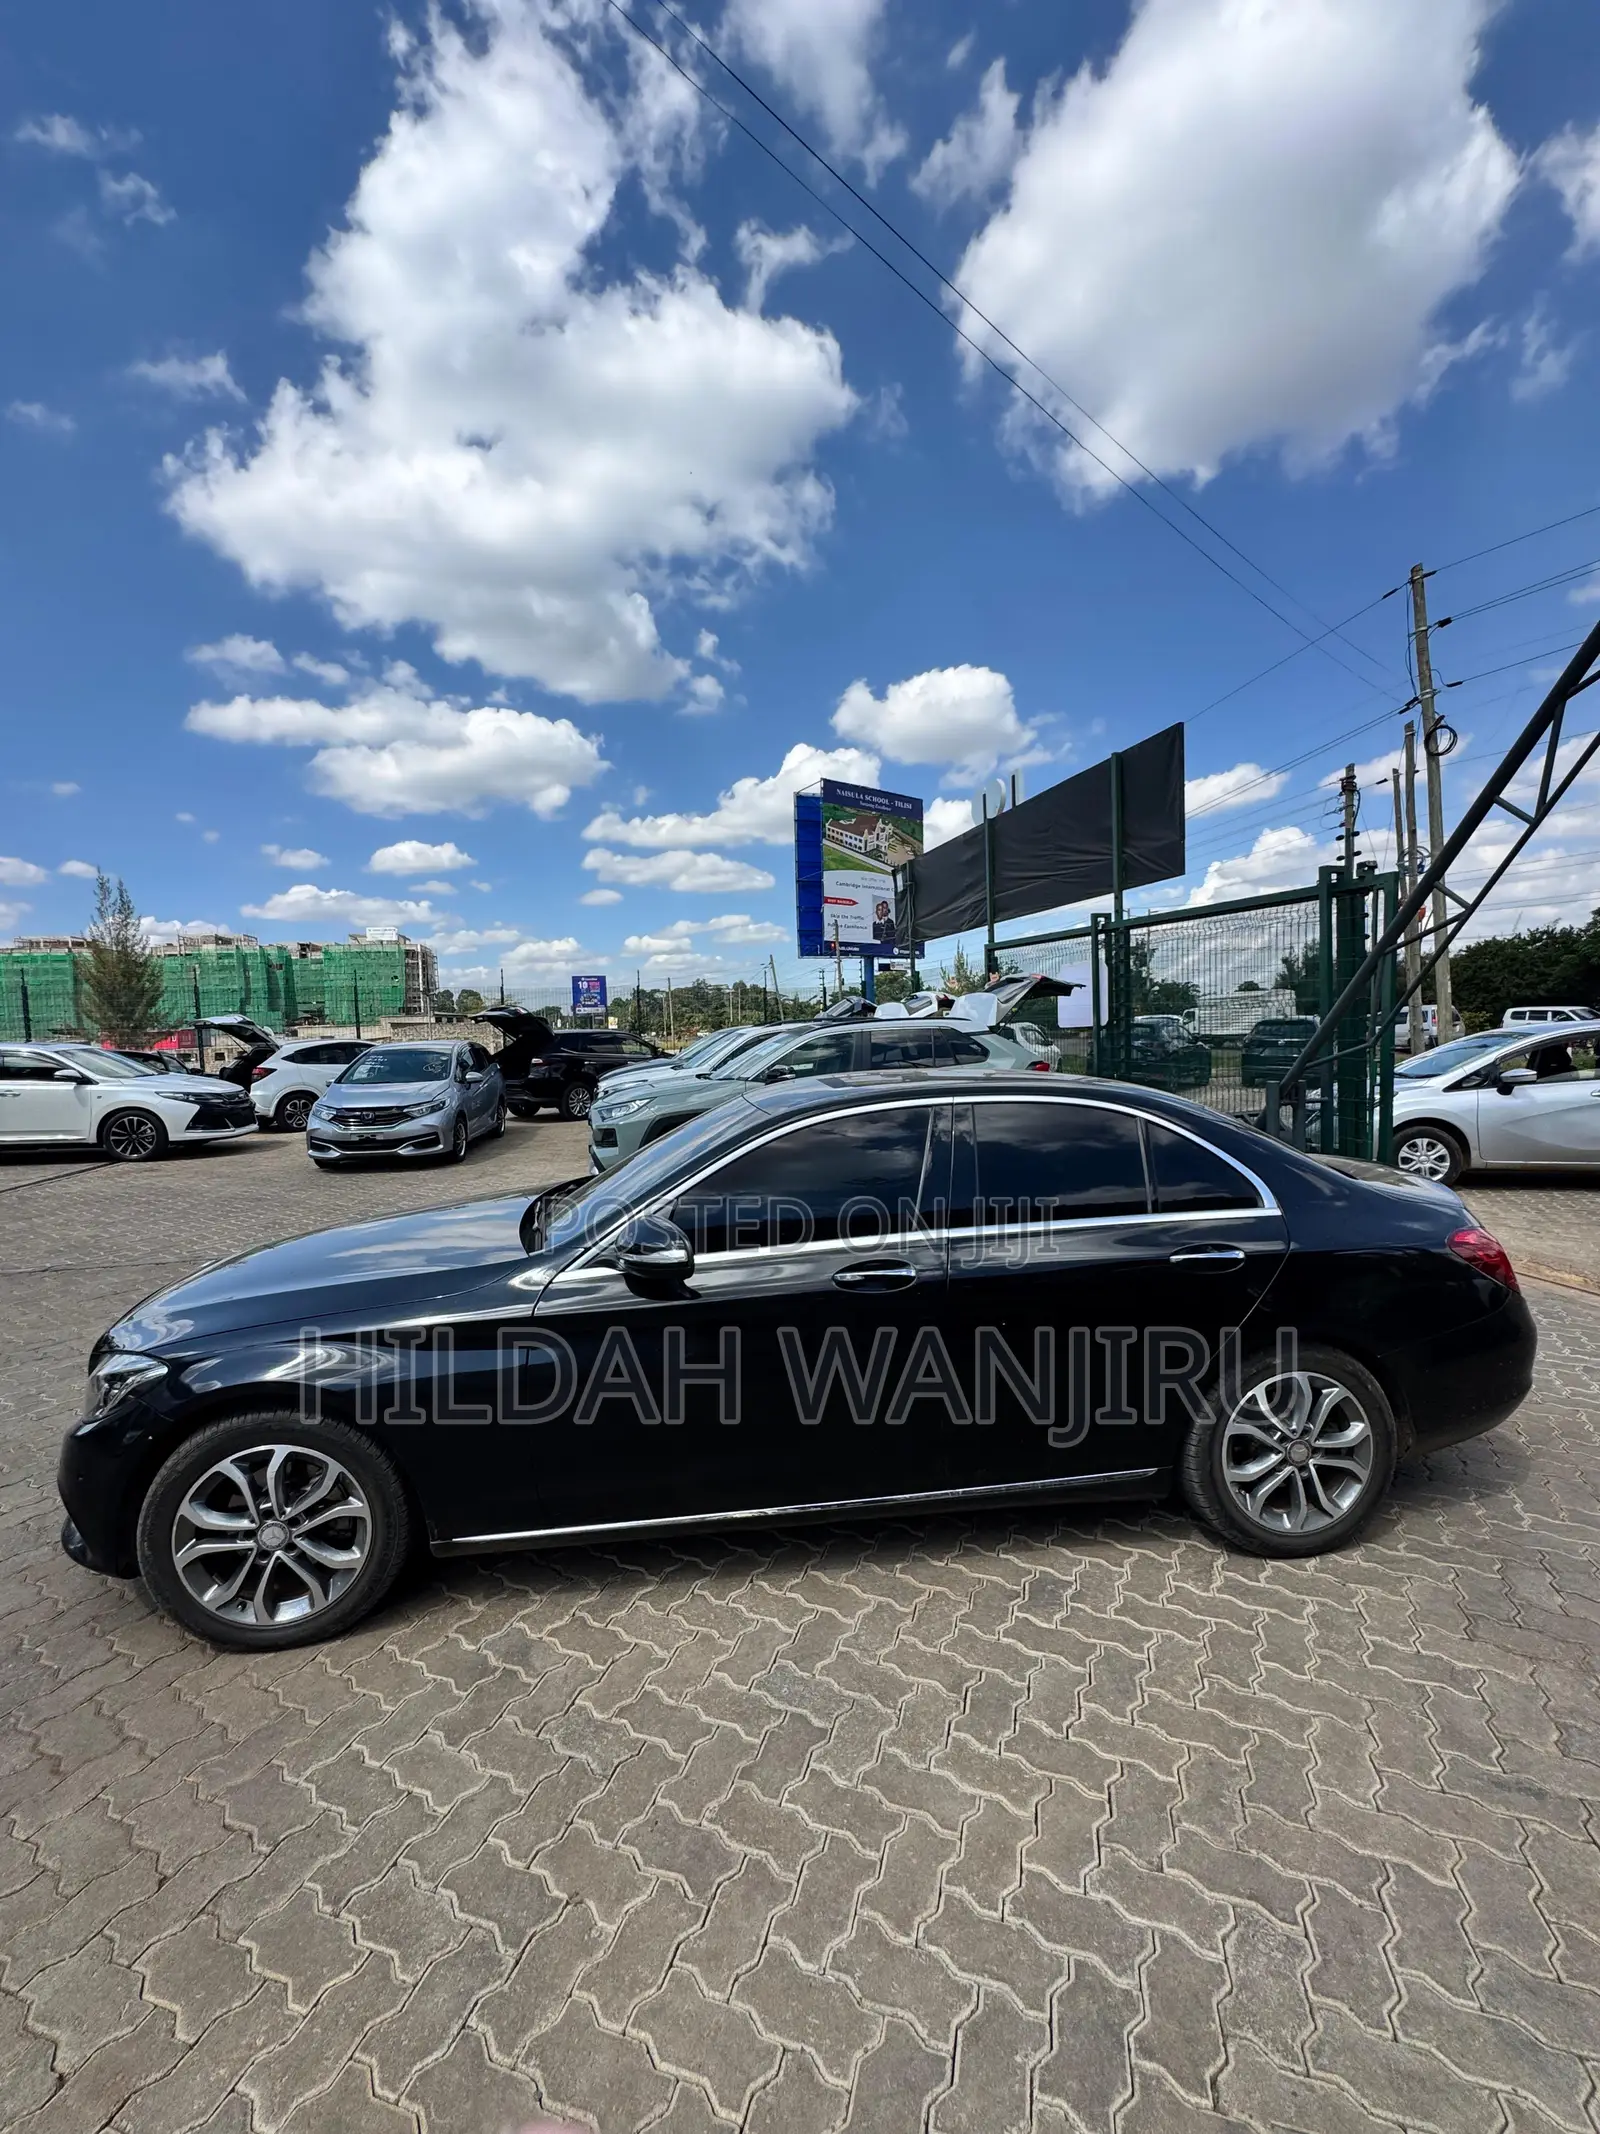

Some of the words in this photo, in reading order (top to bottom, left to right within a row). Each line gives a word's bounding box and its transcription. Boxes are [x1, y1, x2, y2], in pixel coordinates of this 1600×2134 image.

[836, 788, 863, 800] NAISULA
[865, 794, 890, 805] SCHOOL
[836, 881, 860, 889] Cambridge
